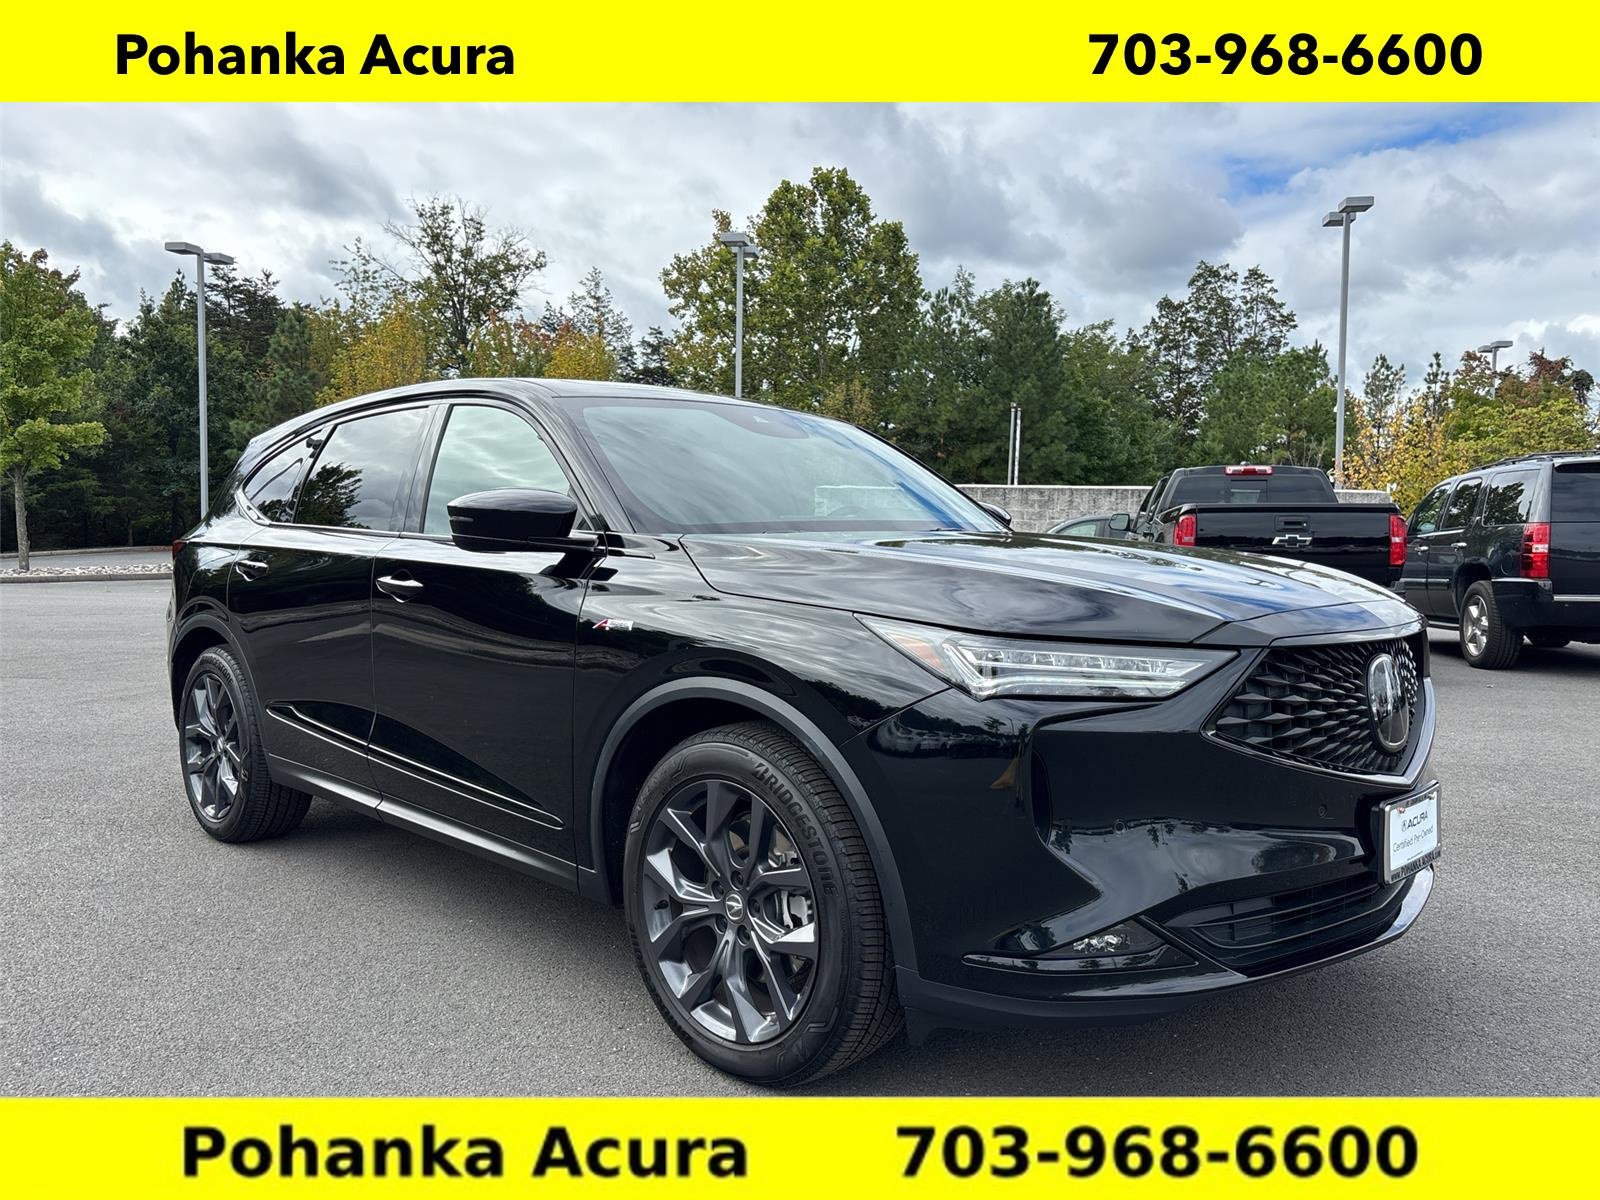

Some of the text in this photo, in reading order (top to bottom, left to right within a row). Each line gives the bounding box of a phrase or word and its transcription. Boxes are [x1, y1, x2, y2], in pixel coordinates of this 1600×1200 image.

[1407, 810, 1428, 828] ACURA
[752, 762, 839, 896] BRIDGESTONE
[1392, 836, 1413, 853] Certified
